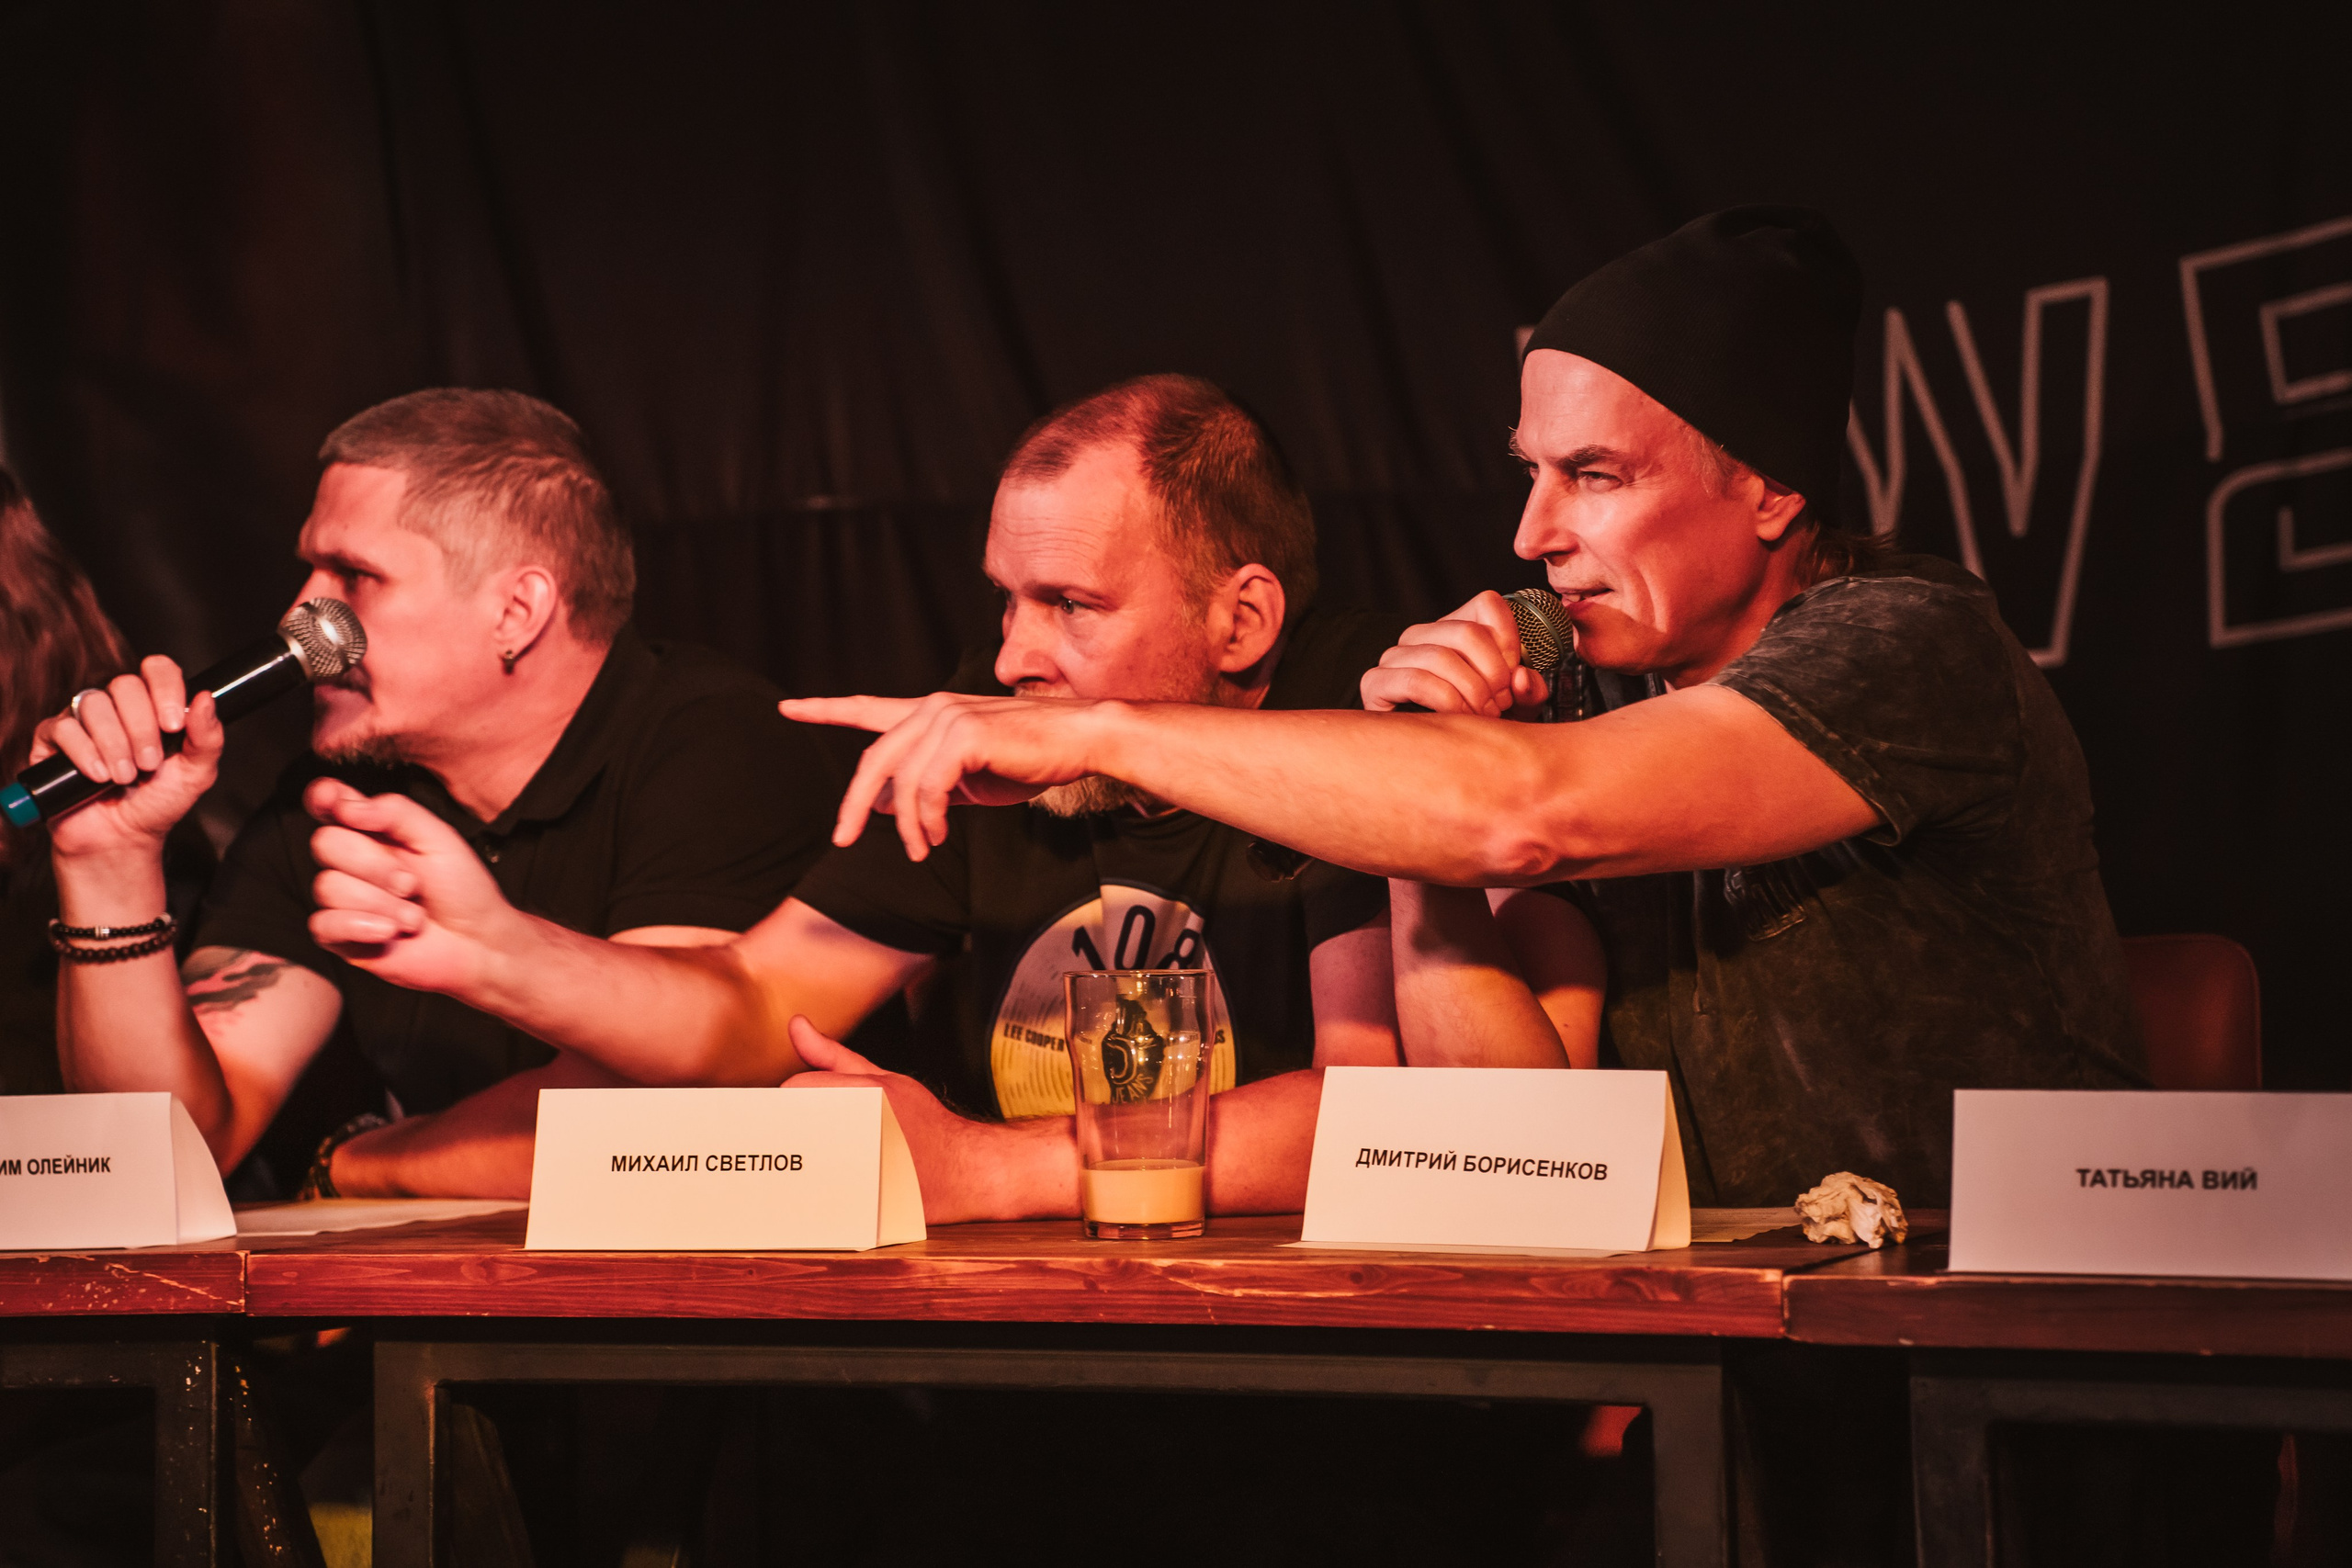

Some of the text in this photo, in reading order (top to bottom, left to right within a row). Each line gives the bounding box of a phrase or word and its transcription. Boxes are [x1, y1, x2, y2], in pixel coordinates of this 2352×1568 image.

[1025, 1029, 1065, 1053] COOPER
[27, 1154, 111, 1175] ОЛЕЙНИК
[611, 1154, 803, 1172] МИХАИЛ СВЕТЛОВ
[1355, 1148, 1608, 1181] ДМИТРИЙ БОРИСЕНКОВ
[2075, 1166, 2259, 1191] ТАТЬЯНА ВИЙ
